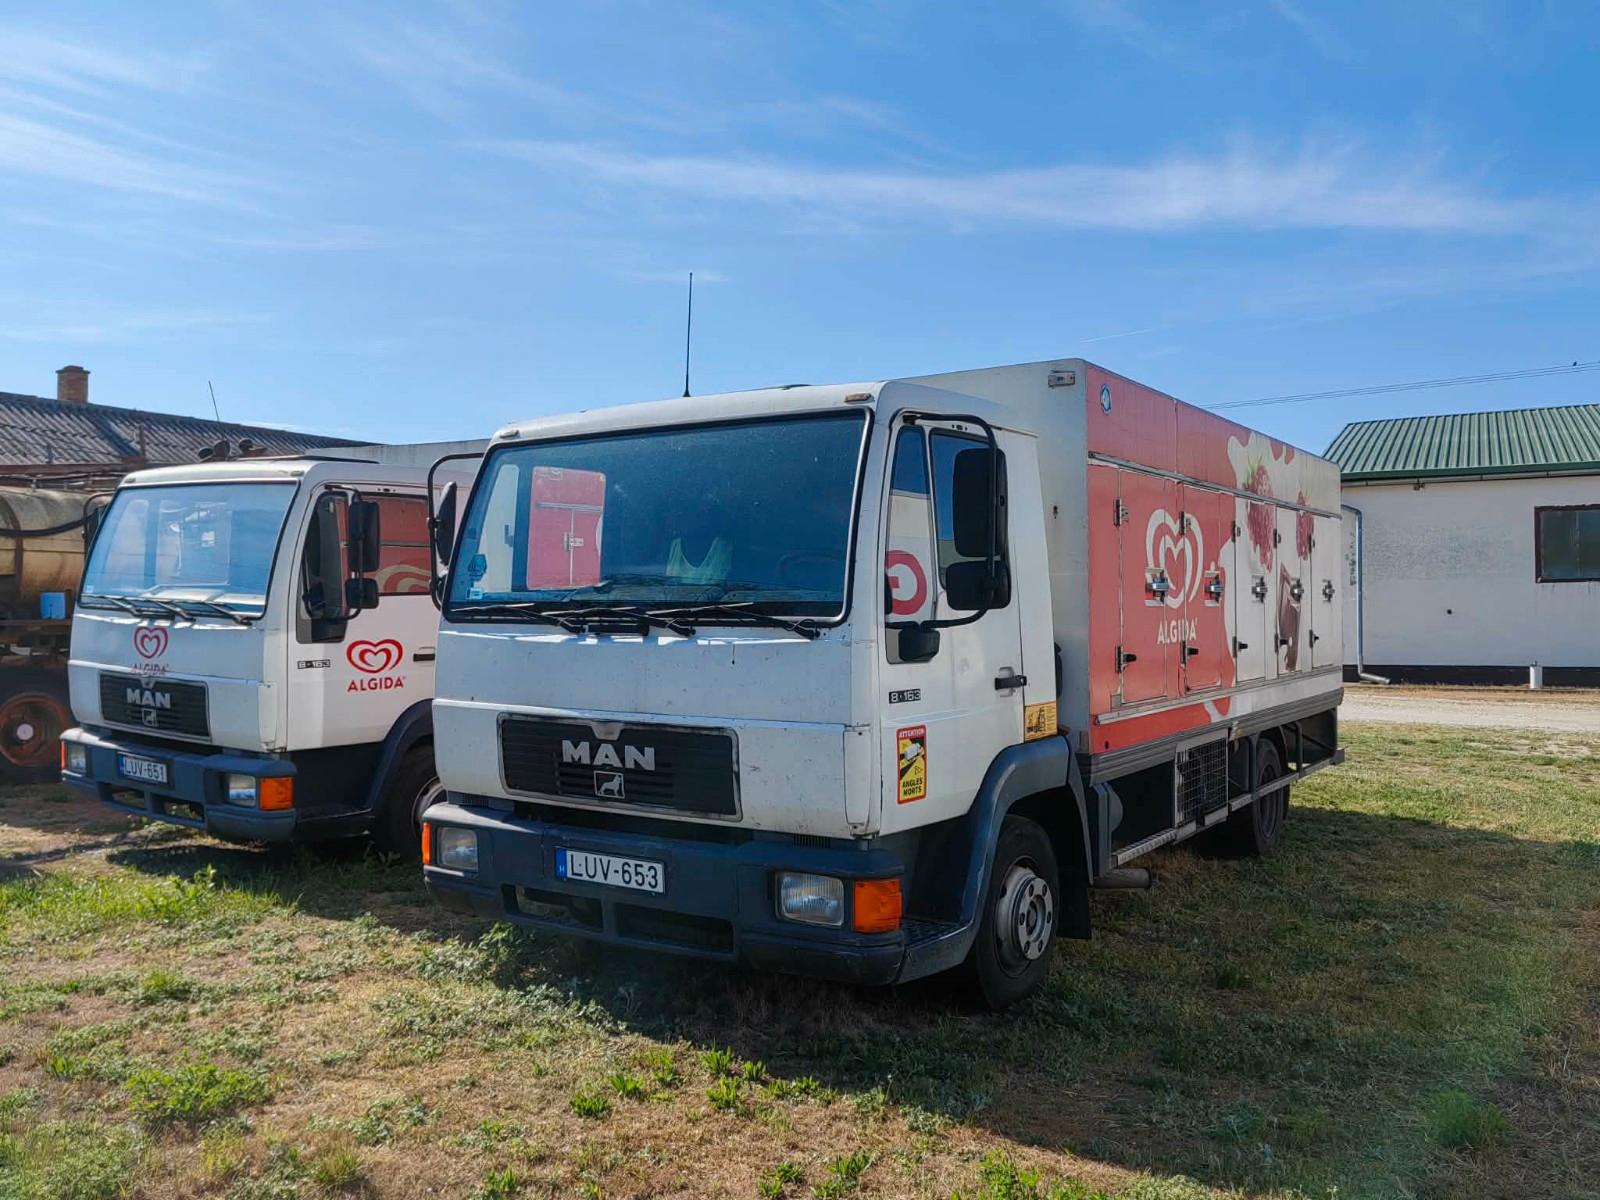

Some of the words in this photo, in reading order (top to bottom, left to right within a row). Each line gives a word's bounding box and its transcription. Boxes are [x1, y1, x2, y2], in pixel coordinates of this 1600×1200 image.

[1157, 619, 1197, 645] ALGIDA
[347, 676, 404, 692] ALGIDA
[127, 687, 171, 709] MAN
[562, 739, 656, 771] MAN
[902, 777, 922, 788] ANGLES
[903, 786, 922, 796] MORTS
[570, 854, 658, 889] LUV-653
